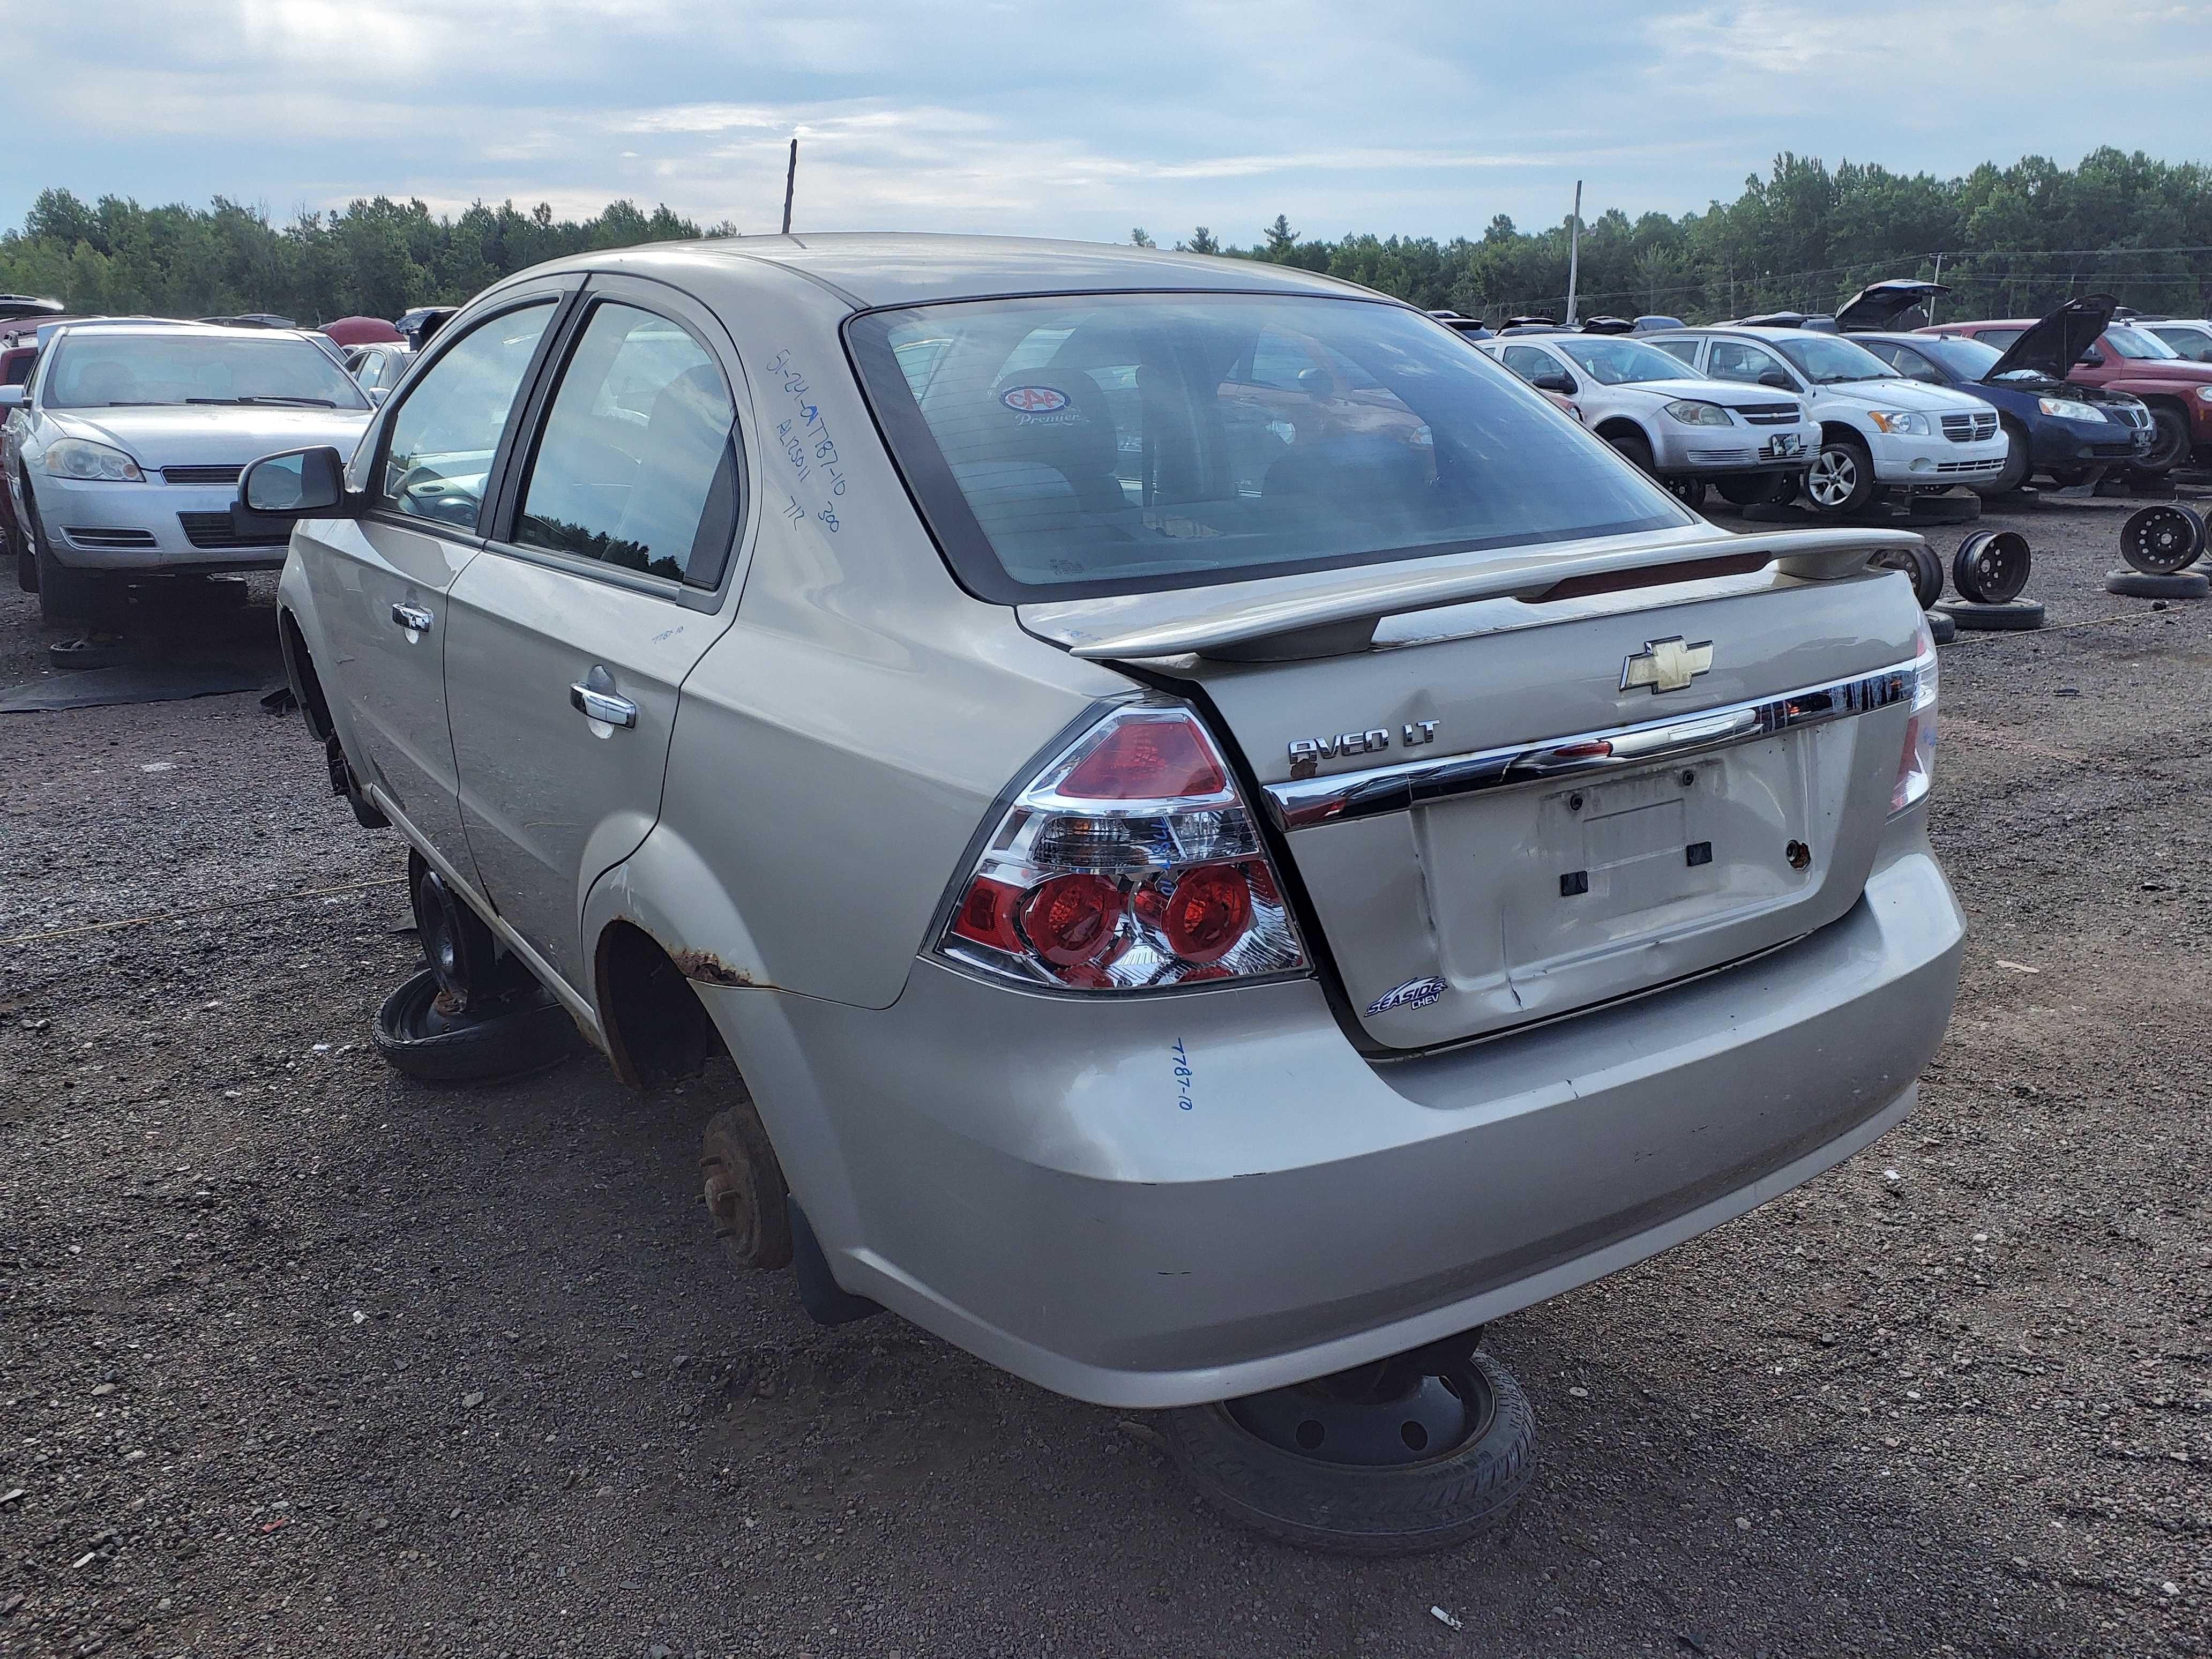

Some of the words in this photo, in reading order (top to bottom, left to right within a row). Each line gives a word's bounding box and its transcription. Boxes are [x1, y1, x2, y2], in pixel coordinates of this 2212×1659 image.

[1008, 389, 1064, 410] CAA
[1015, 413, 1080, 426] Premier
[783, 496, 806, 532] 712
[818, 501, 840, 533] 300
[1288, 728, 1389, 765] AVEO
[1402, 719, 1441, 747] LT
[1366, 979, 1447, 1014] SEASIDE
[1411, 993, 1440, 1010] CHEV
[1171, 1036, 1193, 1110] 7787-10
